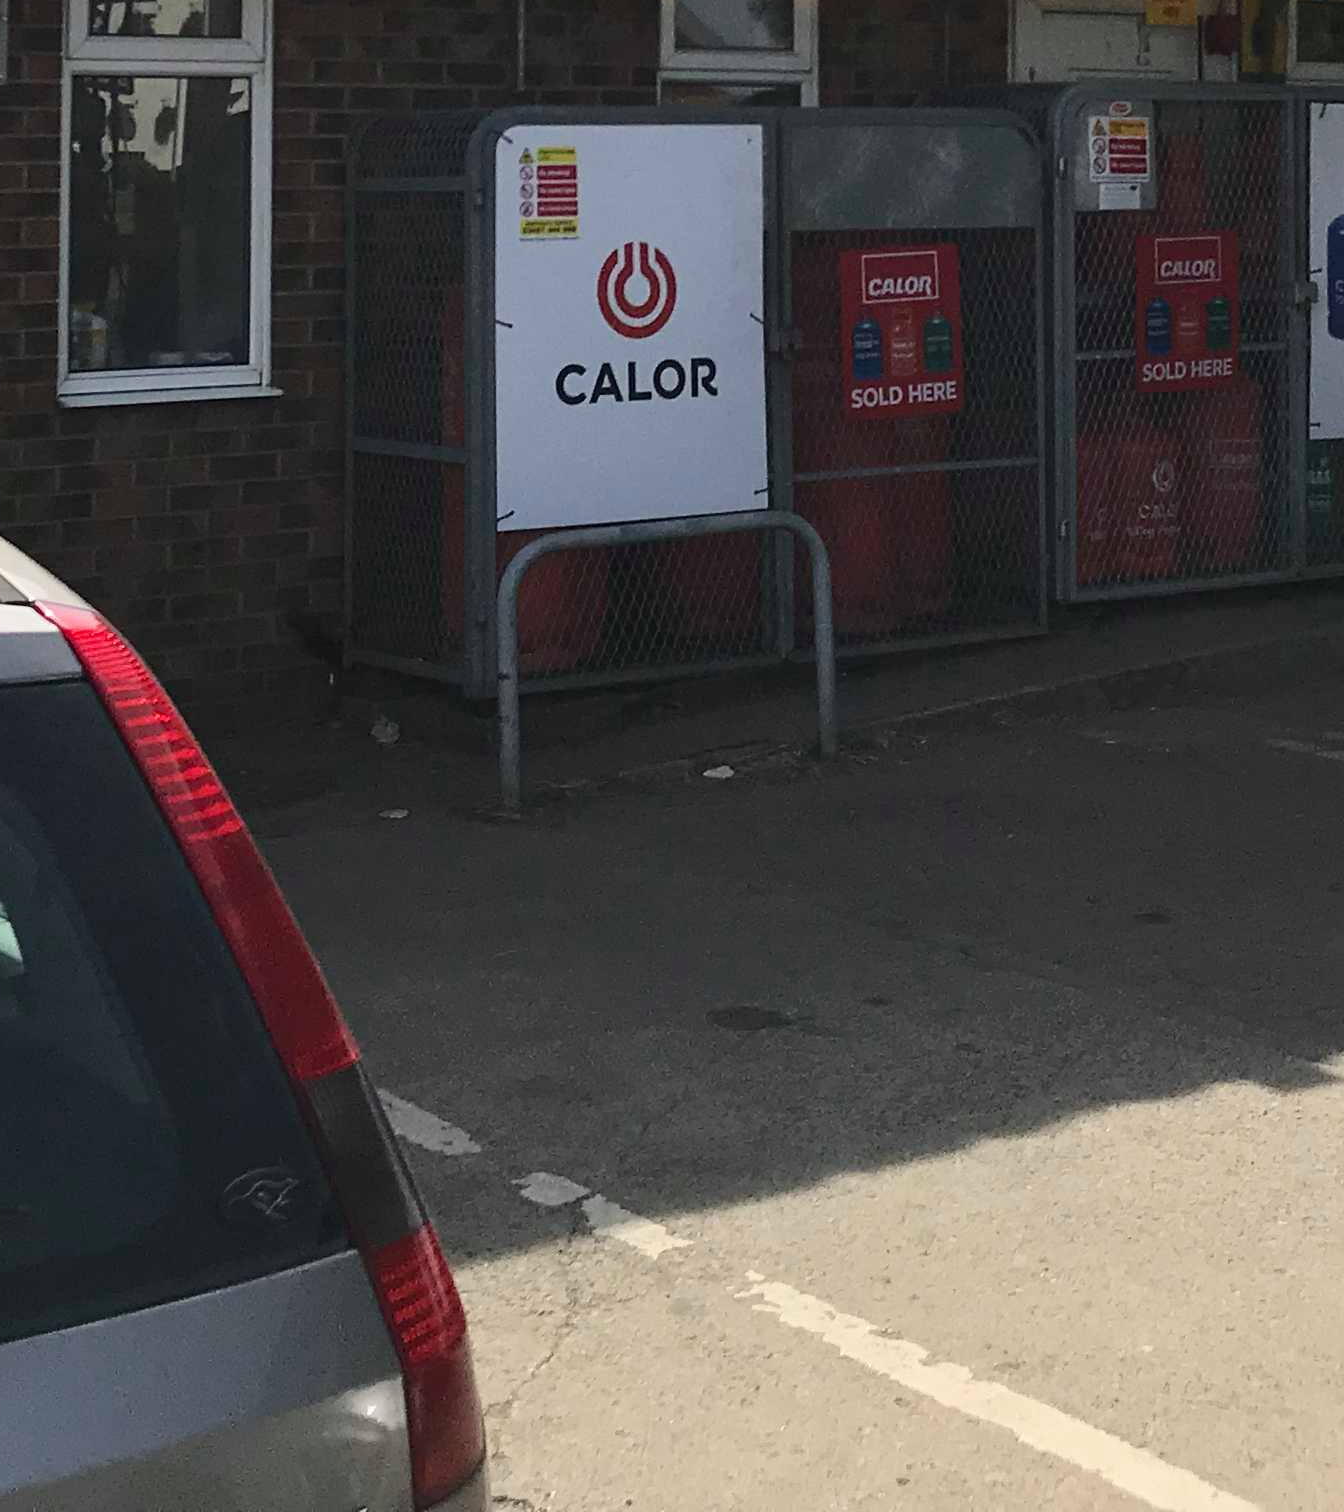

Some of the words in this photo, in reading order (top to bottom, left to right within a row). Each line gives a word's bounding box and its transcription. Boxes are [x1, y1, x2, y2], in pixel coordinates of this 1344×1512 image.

[1159, 259, 1218, 279] CALOR
[867, 275, 934, 297] CALOR
[555, 357, 719, 406] CALOR
[1142, 361, 1187, 383] SOLD
[1191, 357, 1234, 379] HERE
[851, 386, 903, 409] SOLD
[908, 381, 958, 404] HERE
